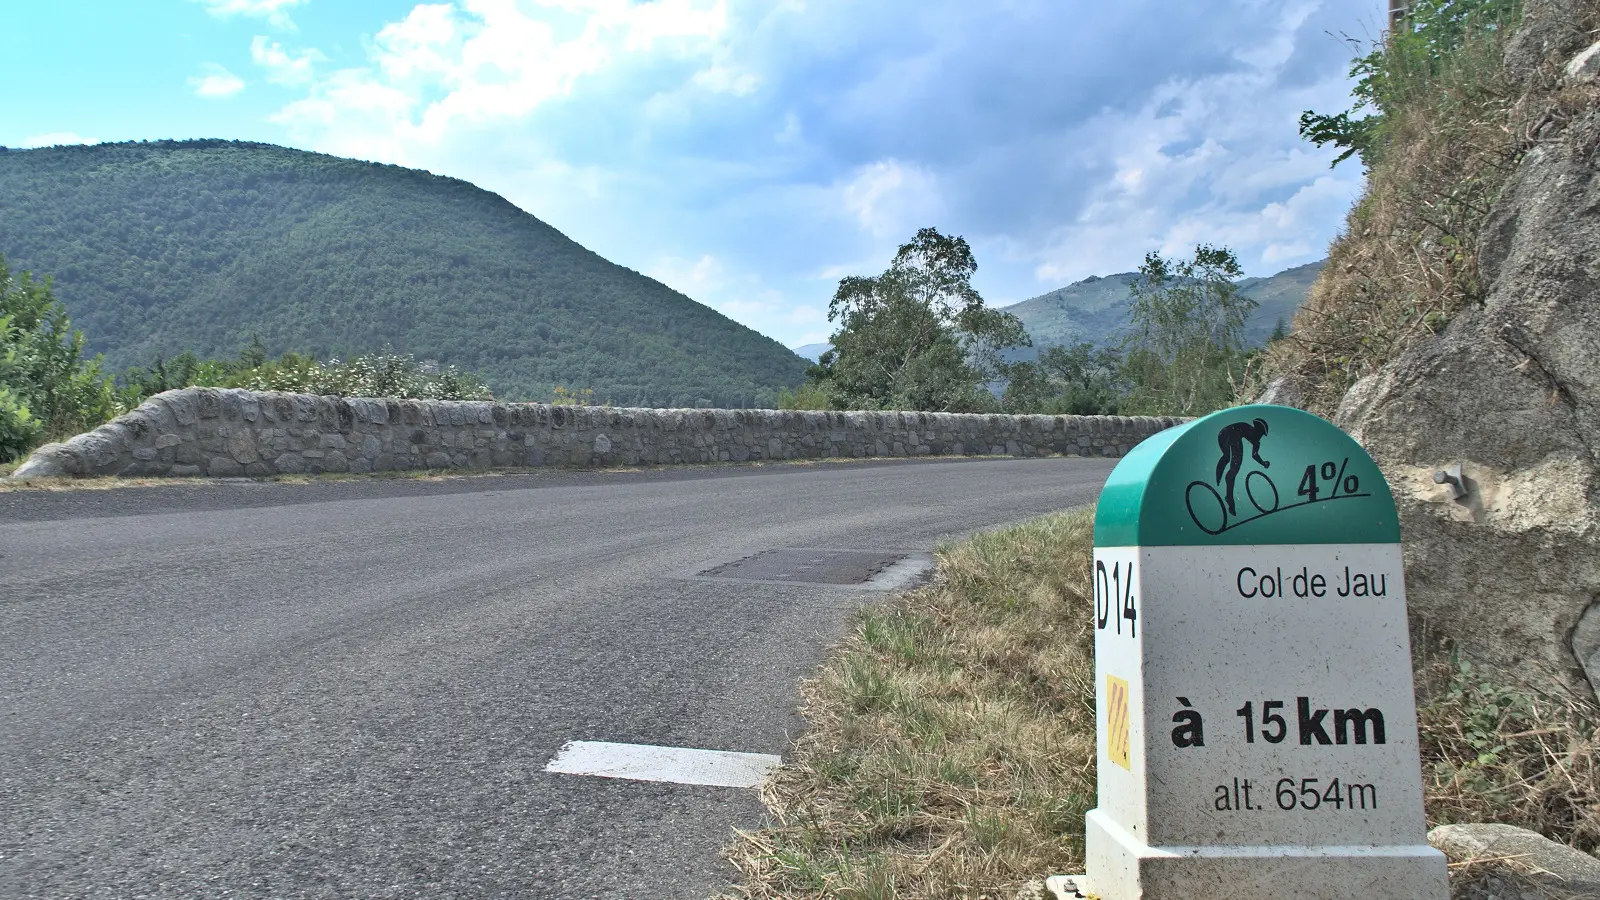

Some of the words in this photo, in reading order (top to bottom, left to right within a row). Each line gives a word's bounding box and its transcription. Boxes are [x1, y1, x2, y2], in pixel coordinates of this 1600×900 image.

[1297, 457, 1360, 502] 4%
[1236, 566, 1282, 599] Col
[1292, 566, 1327, 598] de
[1336, 566, 1386, 598] Jau
[1171, 696, 1206, 749] à
[1236, 700, 1287, 744] 15
[1296, 696, 1386, 746] km
[1214, 776, 1263, 811] alt.
[1275, 777, 1377, 811] 654m
